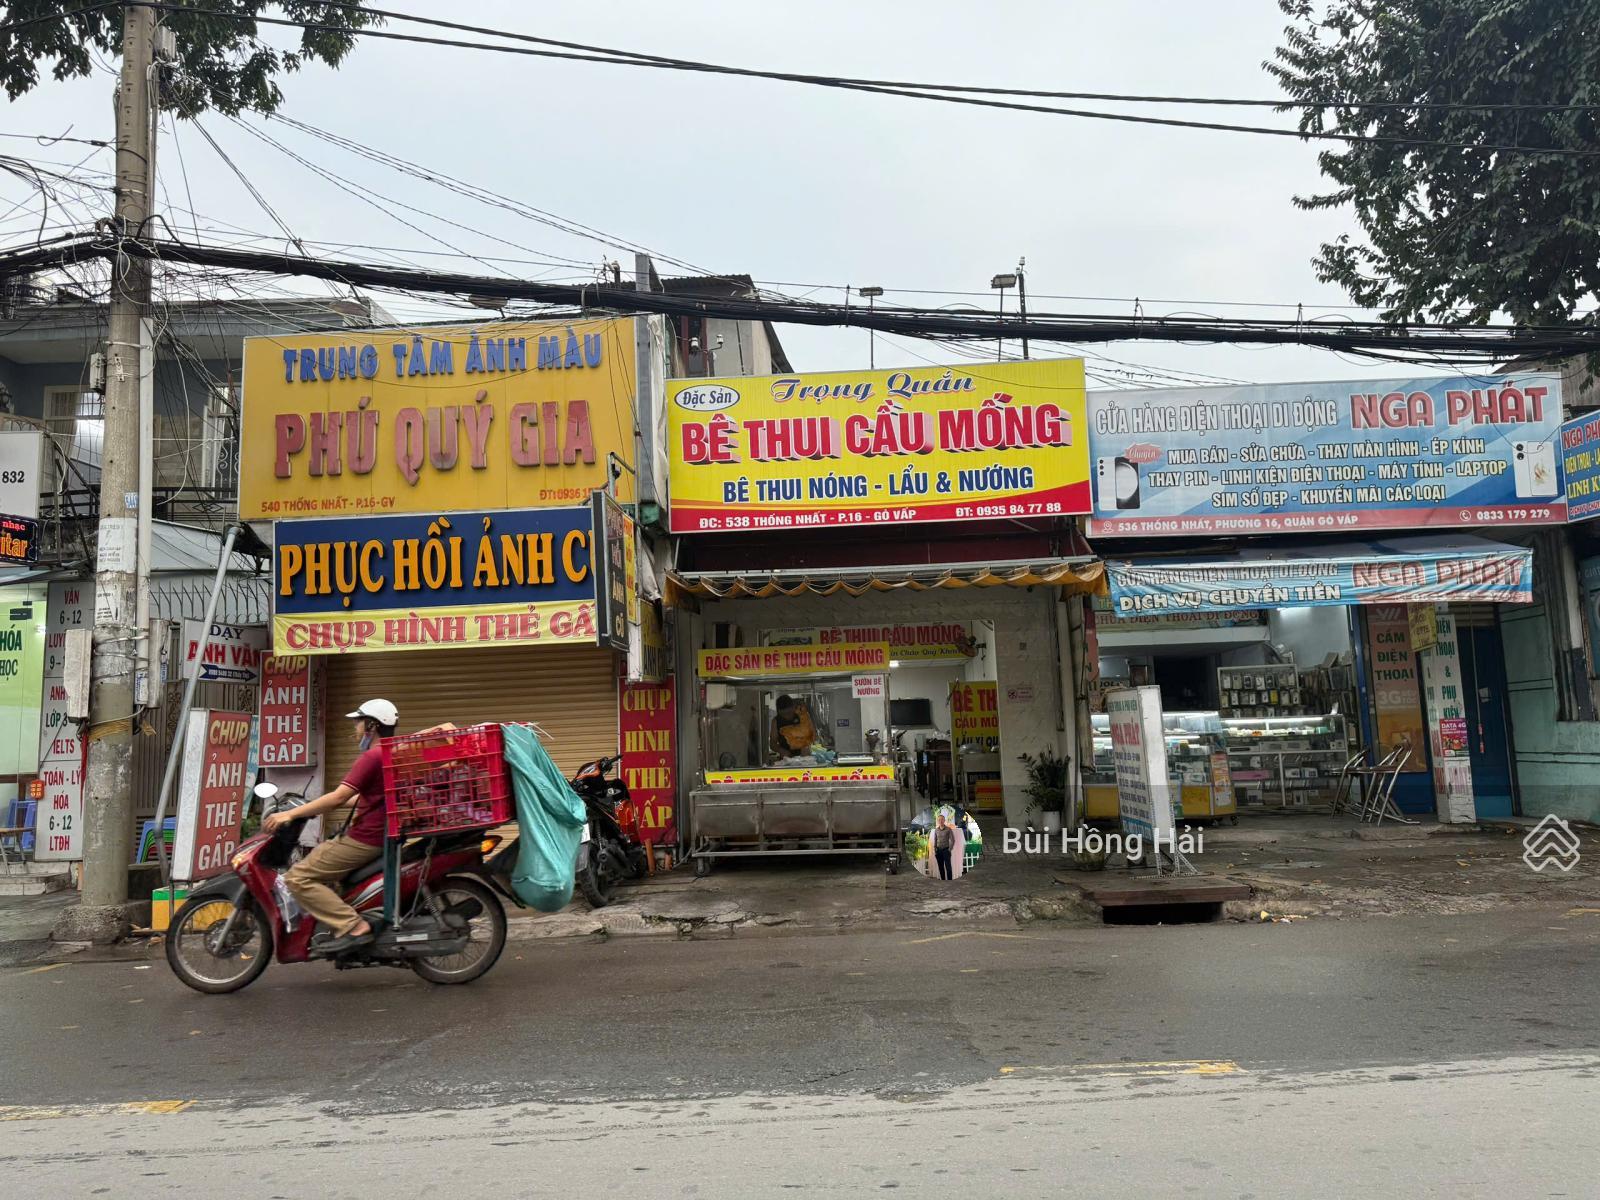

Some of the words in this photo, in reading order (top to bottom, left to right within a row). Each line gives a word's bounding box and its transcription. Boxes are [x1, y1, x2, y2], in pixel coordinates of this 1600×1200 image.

[283, 344, 378, 382] TRUNG
[393, 335, 454, 377] TÂM
[465, 329, 527, 374] ẢNH
[537, 324, 602, 371] MÀU
[681, 391, 708, 407] Đặc
[709, 388, 733, 405] Sản
[770, 377, 874, 405] Trọng
[1095, 401, 1128, 435] CỬA
[1131, 402, 1177, 433] HÀNG
[1179, 399, 1218, 436] ĐIỆN
[1221, 402, 1269, 435] THOẠI
[1273, 402, 1289, 428] DI
[1292, 396, 1338, 432] ĐỘNG
[1350, 391, 1434, 430] NGA
[1446, 382, 1548, 427] PHÁT
[274, 395, 378, 478] PHÚ
[395, 389, 493, 486] QUÝ
[510, 399, 596, 467] GIA
[681, 413, 738, 464] BÊ
[743, 415, 840, 461] THUI
[844, 399, 933, 456] CẦU
[939, 393, 1069, 453] MỐNG
[1562, 426, 1584, 451] NGA
[1167, 447, 1197, 465] MUA
[1200, 442, 1229, 464] BÁN
[1240, 440, 1269, 463] SỬA
[1271, 439, 1305, 462] CHỮA
[1317, 440, 1350, 460] THAY
[1352, 436, 1382, 458] MÀN
[1386, 435, 1420, 457] HÌNH
[1431, 433, 1449, 456] ÉP
[1451, 431, 1485, 454] KÍNH
[2, 471, 25, 484] 832
[723, 476, 748, 503] BÊ
[755, 478, 802, 502] THUI
[809, 471, 868, 499] NÓNG
[888, 464, 928, 496] LẨU
[936, 475, 951, 493] &
[958, 463, 1034, 490] NƯỚNG
[1148, 468, 1181, 488] THAY
[1184, 468, 1208, 487] PIN
[1220, 467, 1251, 485] LINH
[1255, 463, 1288, 487] KIỆN
[1290, 461, 1320, 486] ĐIỆN
[1322, 462, 1366, 483] THOẠI
[1378, 457, 1409, 479] MÁY
[1412, 456, 1444, 478] TÍNH
[1455, 458, 1508, 477] LAPTOP
[1211, 489, 1238, 508] SIM
[1241, 485, 1260, 507] SỐ
[1262, 488, 1288, 510] ĐẸP
[1300, 482, 1354, 506] KHUYẾN
[1356, 483, 1382, 503] MÃI
[1384, 480, 1412, 503] CÁC
[1415, 484, 1446, 505] LOẠI
[1567, 478, 1590, 499] LINH
[260, 500, 280, 512] 540
[283, 497, 319, 512] THỐNG
[320, 494, 348, 510] NHẤT
[956, 506, 973, 518] ĐT:
[976, 504, 1007, 517] 0935
[1009, 504, 1025, 515] 84
[1027, 503, 1043, 514] 77
[1046, 502, 1061, 513] 88
[1476, 509, 1504, 521] 0833
[1507, 509, 1527, 519] 179
[1529, 508, 1550, 519] 279
[2, 520, 26, 532] nhạc
[699, 517, 723, 529] ĐC:
[725, 516, 750, 528] 538
[753, 511, 793, 527] THỐNG
[795, 510, 827, 526] NHẤT
[837, 511, 862, 523] P.16
[874, 509, 891, 522] GÒ
[891, 508, 917, 522] VẤP
[1117, 521, 1138, 532] 536
[1140, 518, 1178, 531] THỐNG
[1264, 516, 1281, 530] 16,
[1283, 515, 1316, 528] QUẬN
[1317, 514, 1335, 526] GÒ
[1336, 513, 1359, 525] VẤP
[279, 538, 385, 608] PHỤC
[392, 516, 464, 592] HỒI
[473, 516, 555, 588] ẢNH
[561, 529, 594, 583] C
[1352, 562, 1427, 589] NGA
[64, 588, 80, 605] VĂN
[1119, 592, 1170, 612] DỊCH
[1172, 590, 1203, 611] VỤ
[1208, 583, 1290, 605] CHUYỂN
[1295, 580, 1341, 602] TIỀN
[59, 610, 65, 624] 6
[72, 609, 82, 624] 12
[285, 619, 376, 654] CHỤP
[384, 611, 466, 645] HÌNH
[474, 604, 540, 642] THẺ
[209, 625, 245, 641] DẠY
[50, 655, 55, 670] 9
[264, 656, 307, 680] CHỤP
[705, 655, 731, 675] ĐẶC
[734, 648, 760, 670] SẢN
[765, 651, 781, 669] BÊ
[786, 651, 813, 668] THUI
[1445, 666, 1452, 678] &
[1375, 668, 1414, 683] THOẠI
[50, 686, 66, 701] ANH
[263, 680, 305, 705] ẢNH
[622, 688, 672, 717] CHỤP
[1441, 686, 1457, 703] PHỤ
[45, 708, 61, 728] LỚP
[265, 708, 303, 734] THẺ
[52, 739, 75, 755] IELTS
[209, 720, 248, 752] CHỤP
[624, 724, 671, 753] HÌNH
[262, 738, 305, 763] GẤP
[43, 763, 64, 784] TOÁN
[205, 753, 242, 789] ẢNH
[625, 758, 672, 790] THẺ
[53, 790, 69, 810] HÓA
[204, 792, 236, 829] THẺ
[635, 795, 673, 829] ẤP
[49, 815, 55, 830] 6
[62, 814, 72, 829] 12
[48, 834, 71, 852] LTĐH
[198, 835, 235, 871] GẤP
